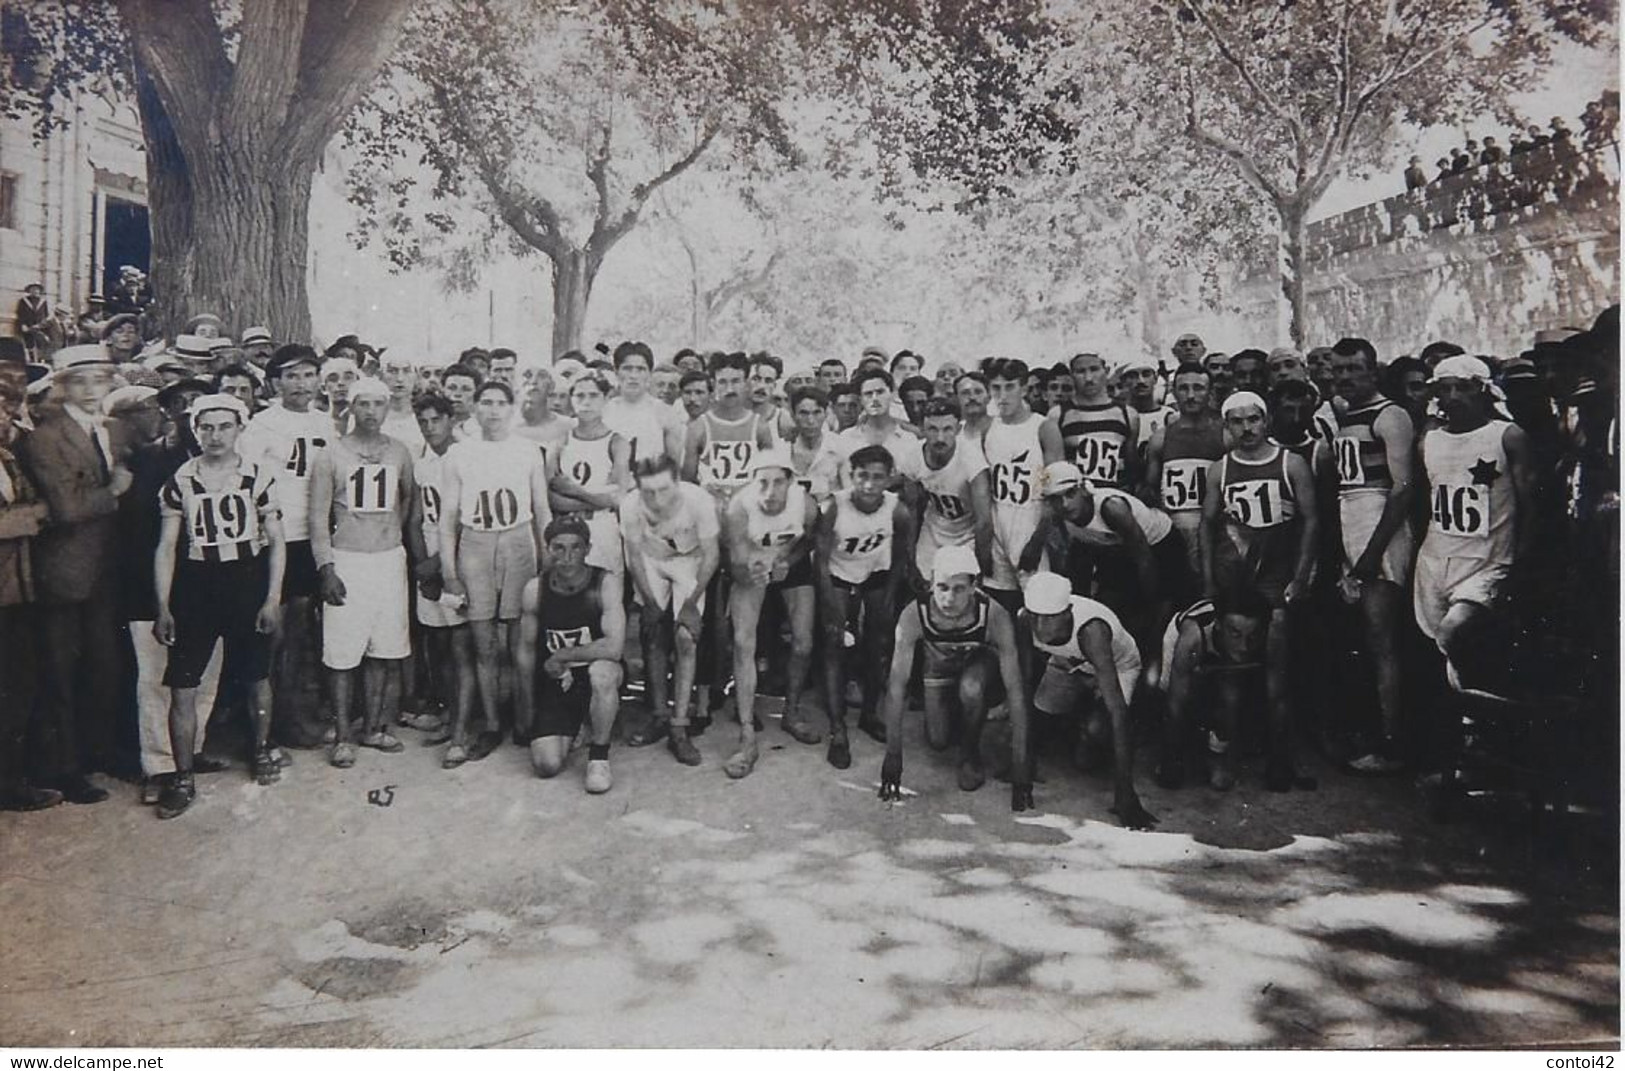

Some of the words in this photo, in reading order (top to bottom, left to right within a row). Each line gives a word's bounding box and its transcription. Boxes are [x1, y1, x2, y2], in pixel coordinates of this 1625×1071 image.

[712, 441, 752, 480] 52
[1078, 438, 1118, 480] 95
[350, 466, 386, 508] 11
[993, 463, 1031, 504] 65
[1166, 466, 1206, 507] 54
[1228, 482, 1273, 524] 51
[195, 494, 247, 543] 49
[473, 487, 518, 529] 40
[1434, 484, 1482, 533] 46
[844, 533, 885, 555] 18
